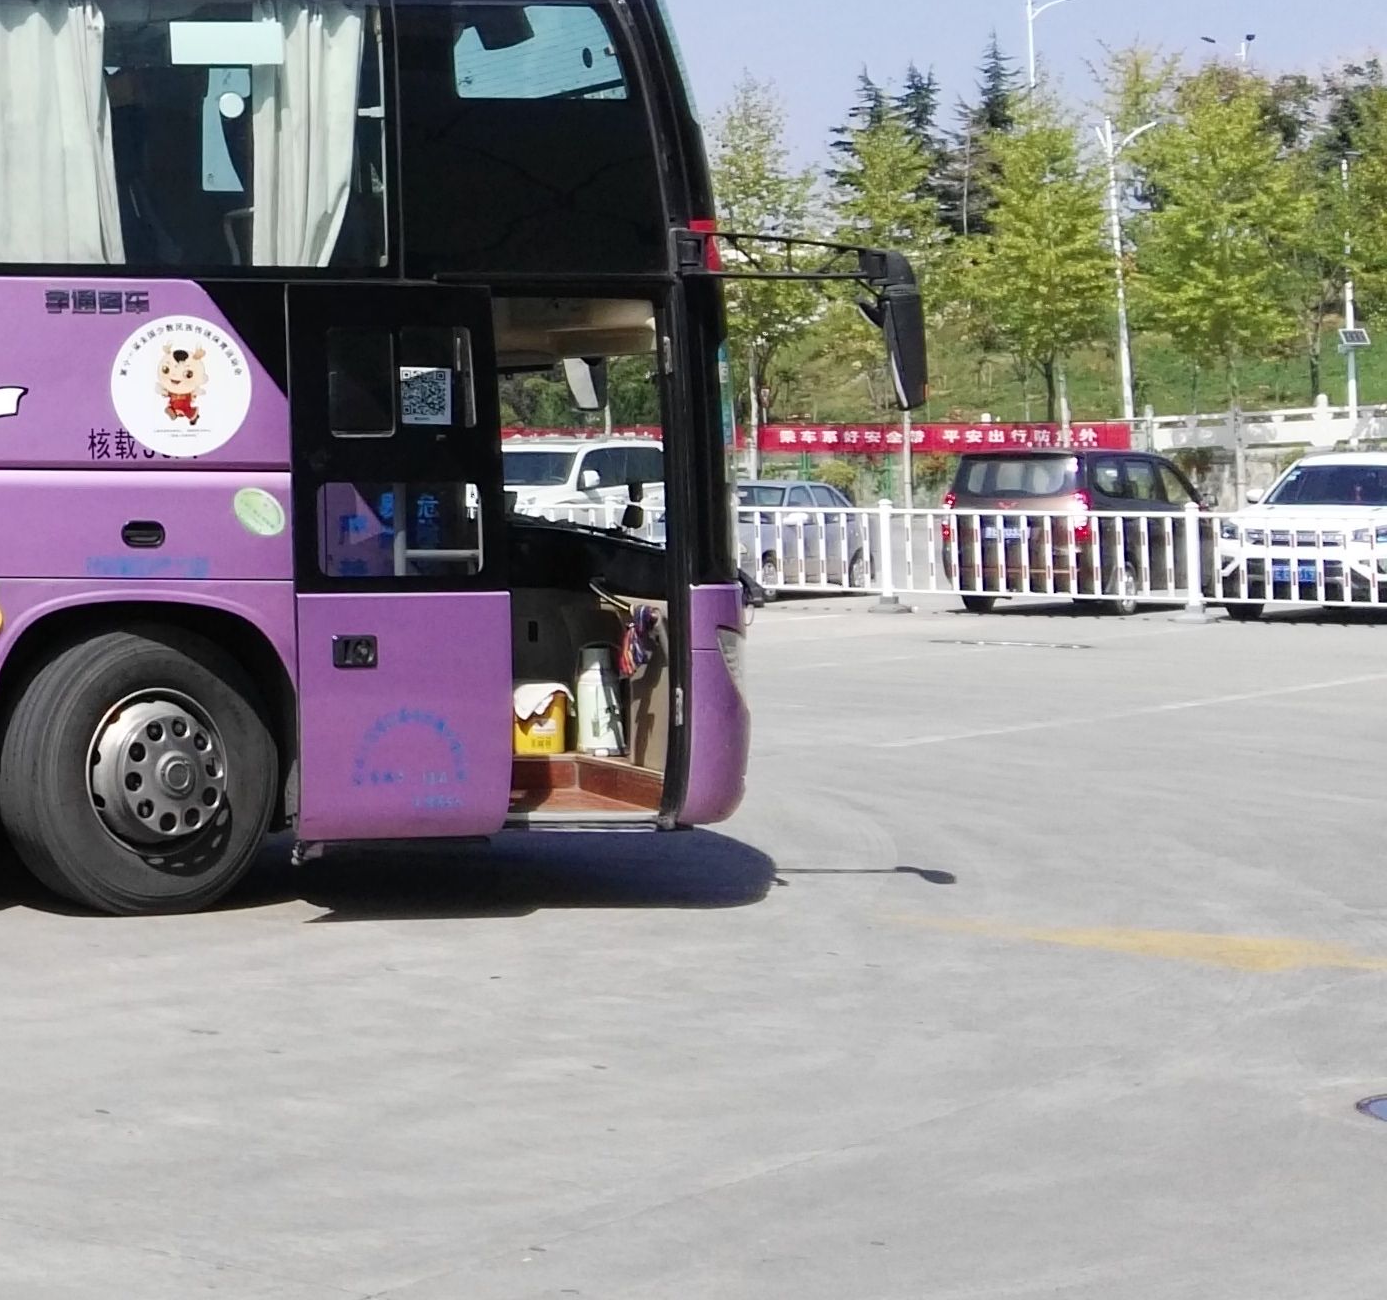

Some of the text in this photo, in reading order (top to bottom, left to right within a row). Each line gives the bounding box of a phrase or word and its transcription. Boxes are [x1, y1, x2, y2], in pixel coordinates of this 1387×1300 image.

[45, 289, 149, 314] 宇通客车
[779, 429, 925, 444] 乘车系好安全带
